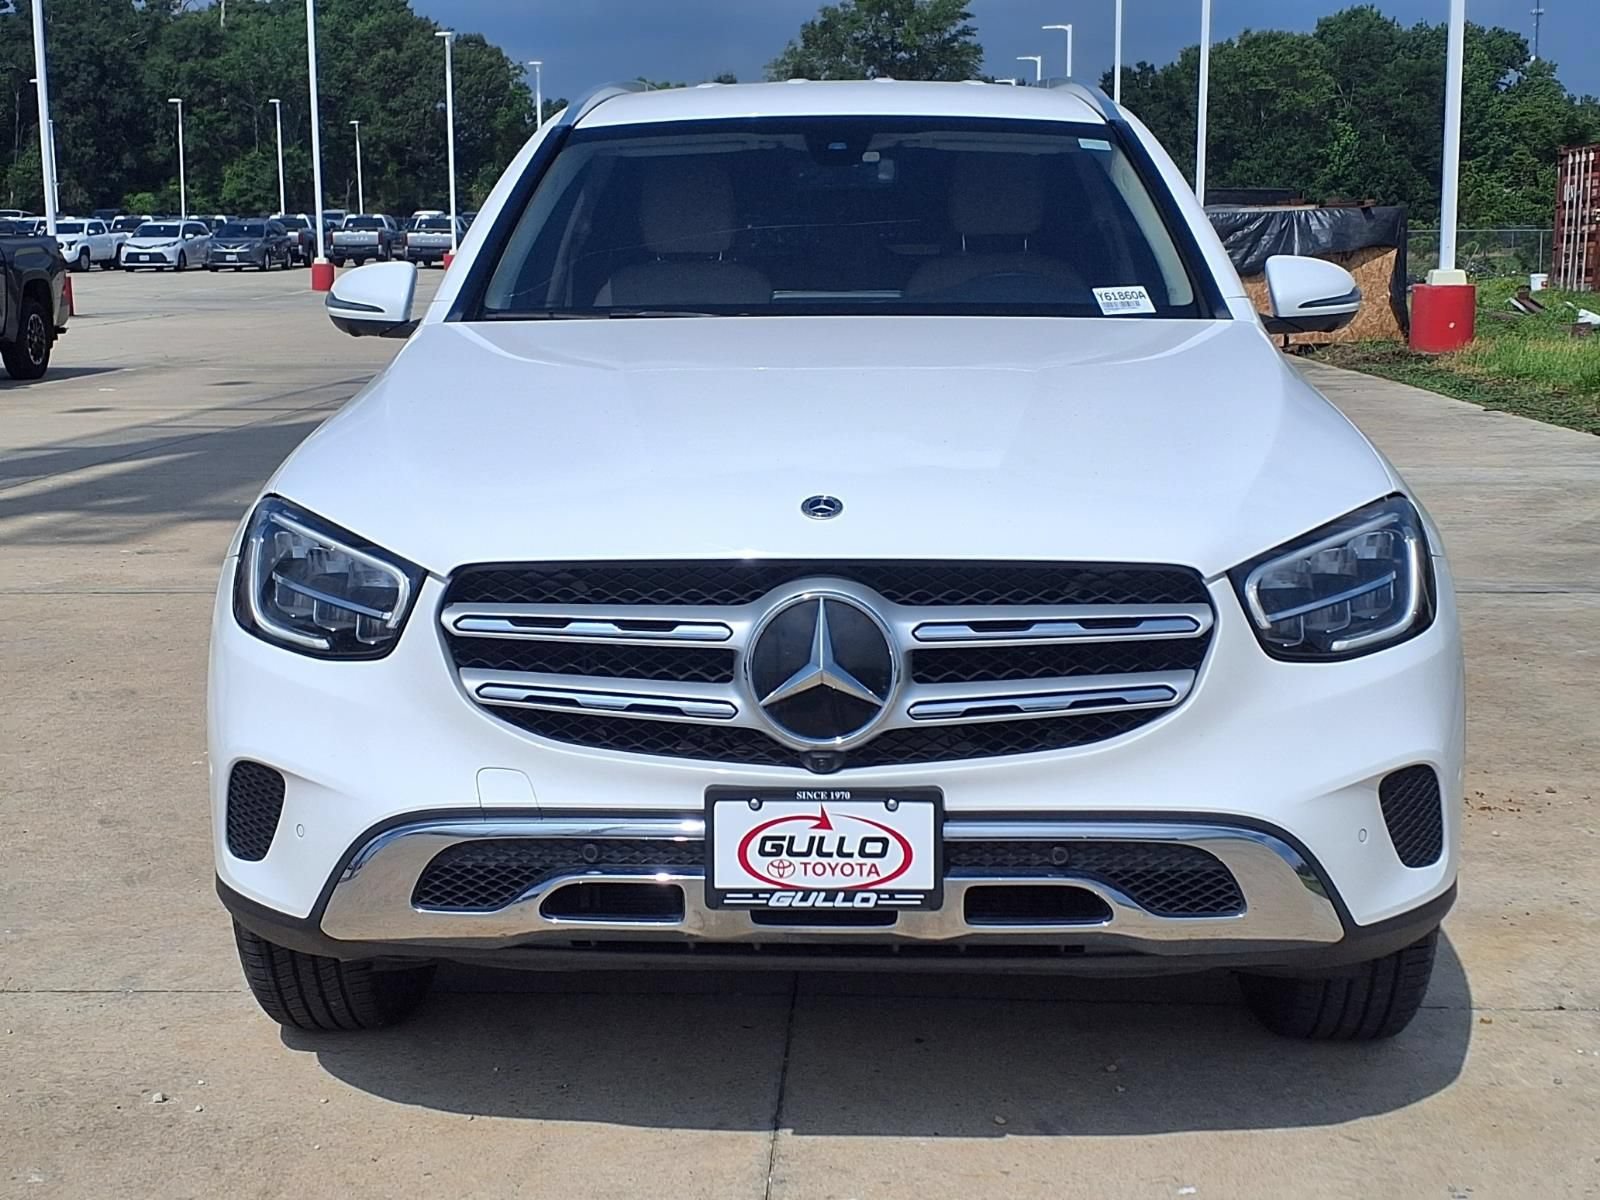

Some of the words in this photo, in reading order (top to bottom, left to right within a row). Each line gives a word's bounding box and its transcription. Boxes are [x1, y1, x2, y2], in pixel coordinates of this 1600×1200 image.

[1097, 291, 1146, 301] Y61860A
[796, 791, 828, 800] SINCE
[830, 791, 851, 800] 1970
[758, 835, 890, 859] GULLO
[800, 862, 881, 877] TOYOTA
[768, 891, 878, 908] GULLO
